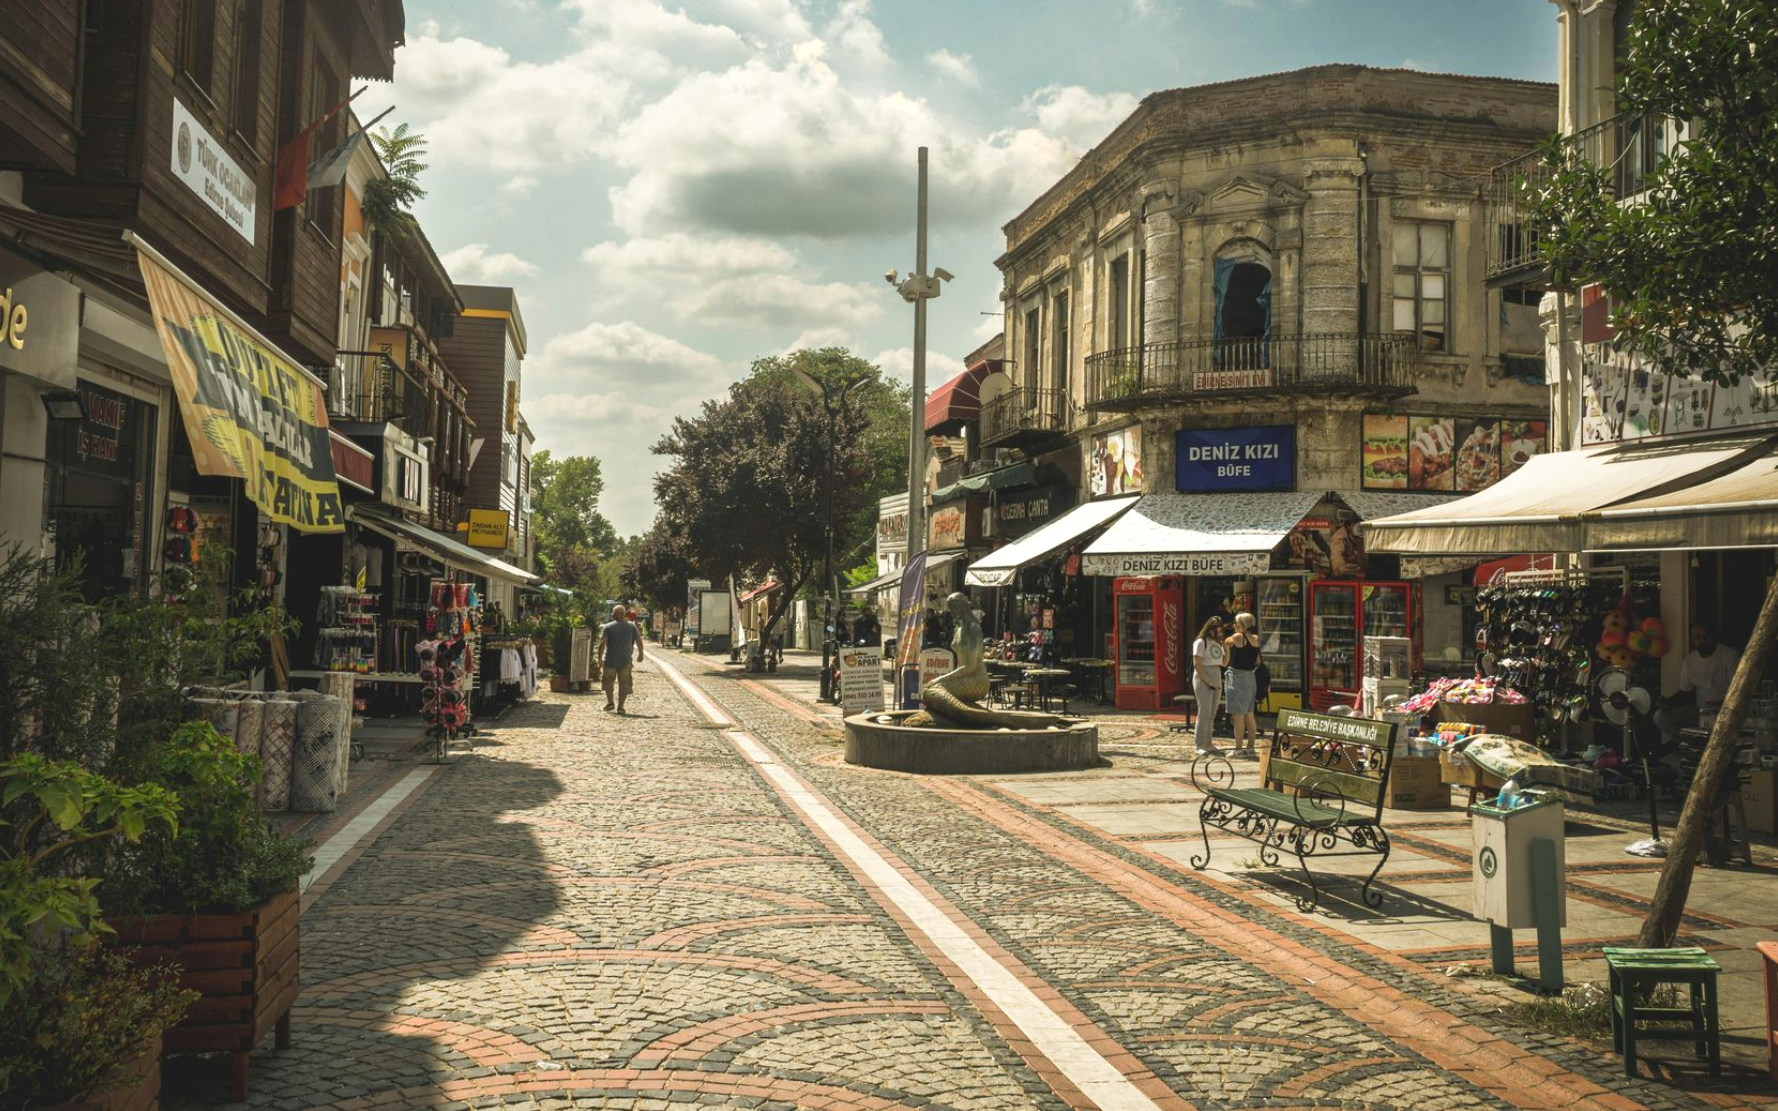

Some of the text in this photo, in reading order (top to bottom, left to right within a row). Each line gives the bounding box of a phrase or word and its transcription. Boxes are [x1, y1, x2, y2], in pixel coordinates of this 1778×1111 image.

[197, 138, 218, 179] TÜRK
[204, 177, 244, 229] Edirne Şubesi
[1227, 372, 1249, 386] SMİT
[1189, 442, 1279, 461] DENİZ KIZI
[1217, 464, 1251, 476] BÜFE
[1028, 498, 1049, 521] ÇANTA
[1123, 558, 1160, 571] DENİZ
[1163, 559, 1188, 570] KIZI
[1192, 556, 1223, 570] BÜFE
[1121, 580, 1146, 590] Coca-Cola
[1163, 600, 1178, 675] Coca-Cola
[857, 658, 881, 667] APART
[1287, 713, 1377, 741] EDİRNE BELEDİYE BAŞKANLIĞI
